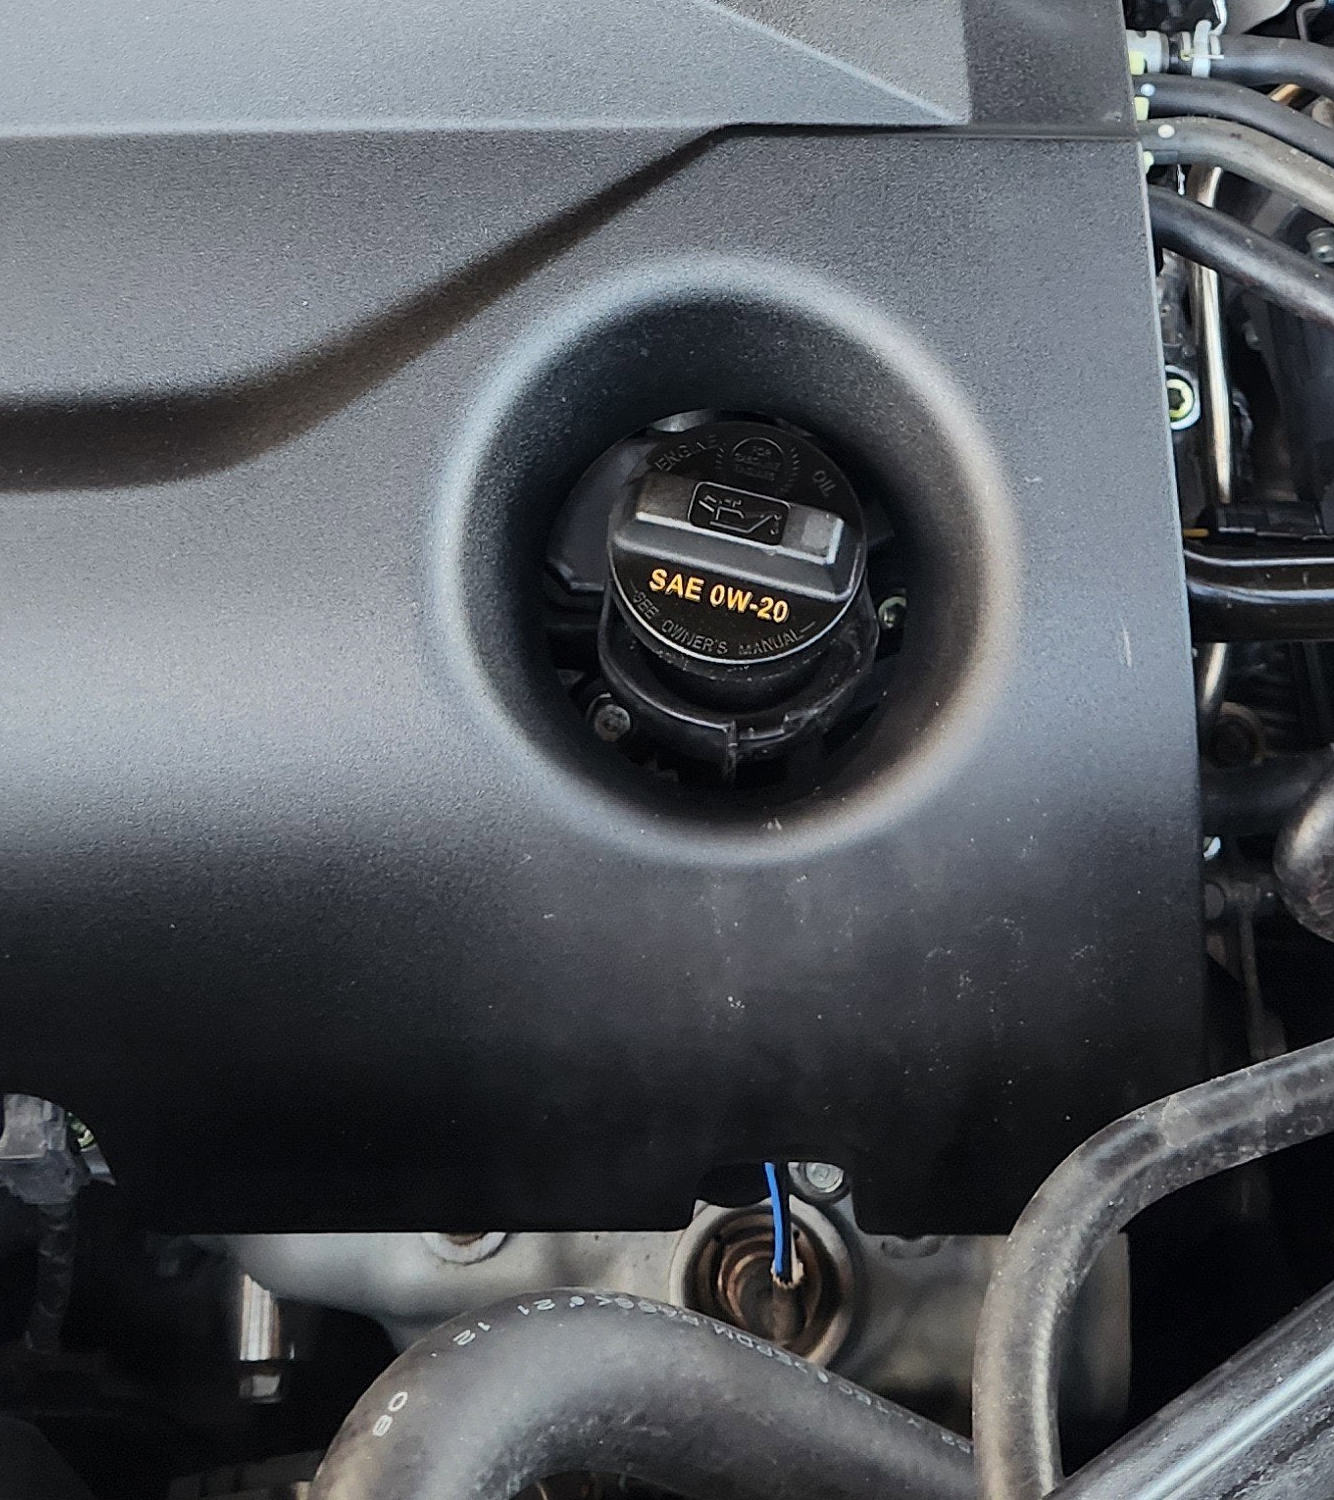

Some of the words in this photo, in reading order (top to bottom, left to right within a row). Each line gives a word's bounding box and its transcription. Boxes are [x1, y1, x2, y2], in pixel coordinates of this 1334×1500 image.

[654, 434, 719, 472] ENGNE
[812, 469, 836, 498] OIL
[633, 591, 660, 620] SEE
[662, 619, 729, 655] OWNER'S
[738, 628, 806, 655] MANUAL
[649, 568, 706, 601] SAE
[709, 583, 789, 624] 0W-20
[517, 1298, 556, 1316] 21
